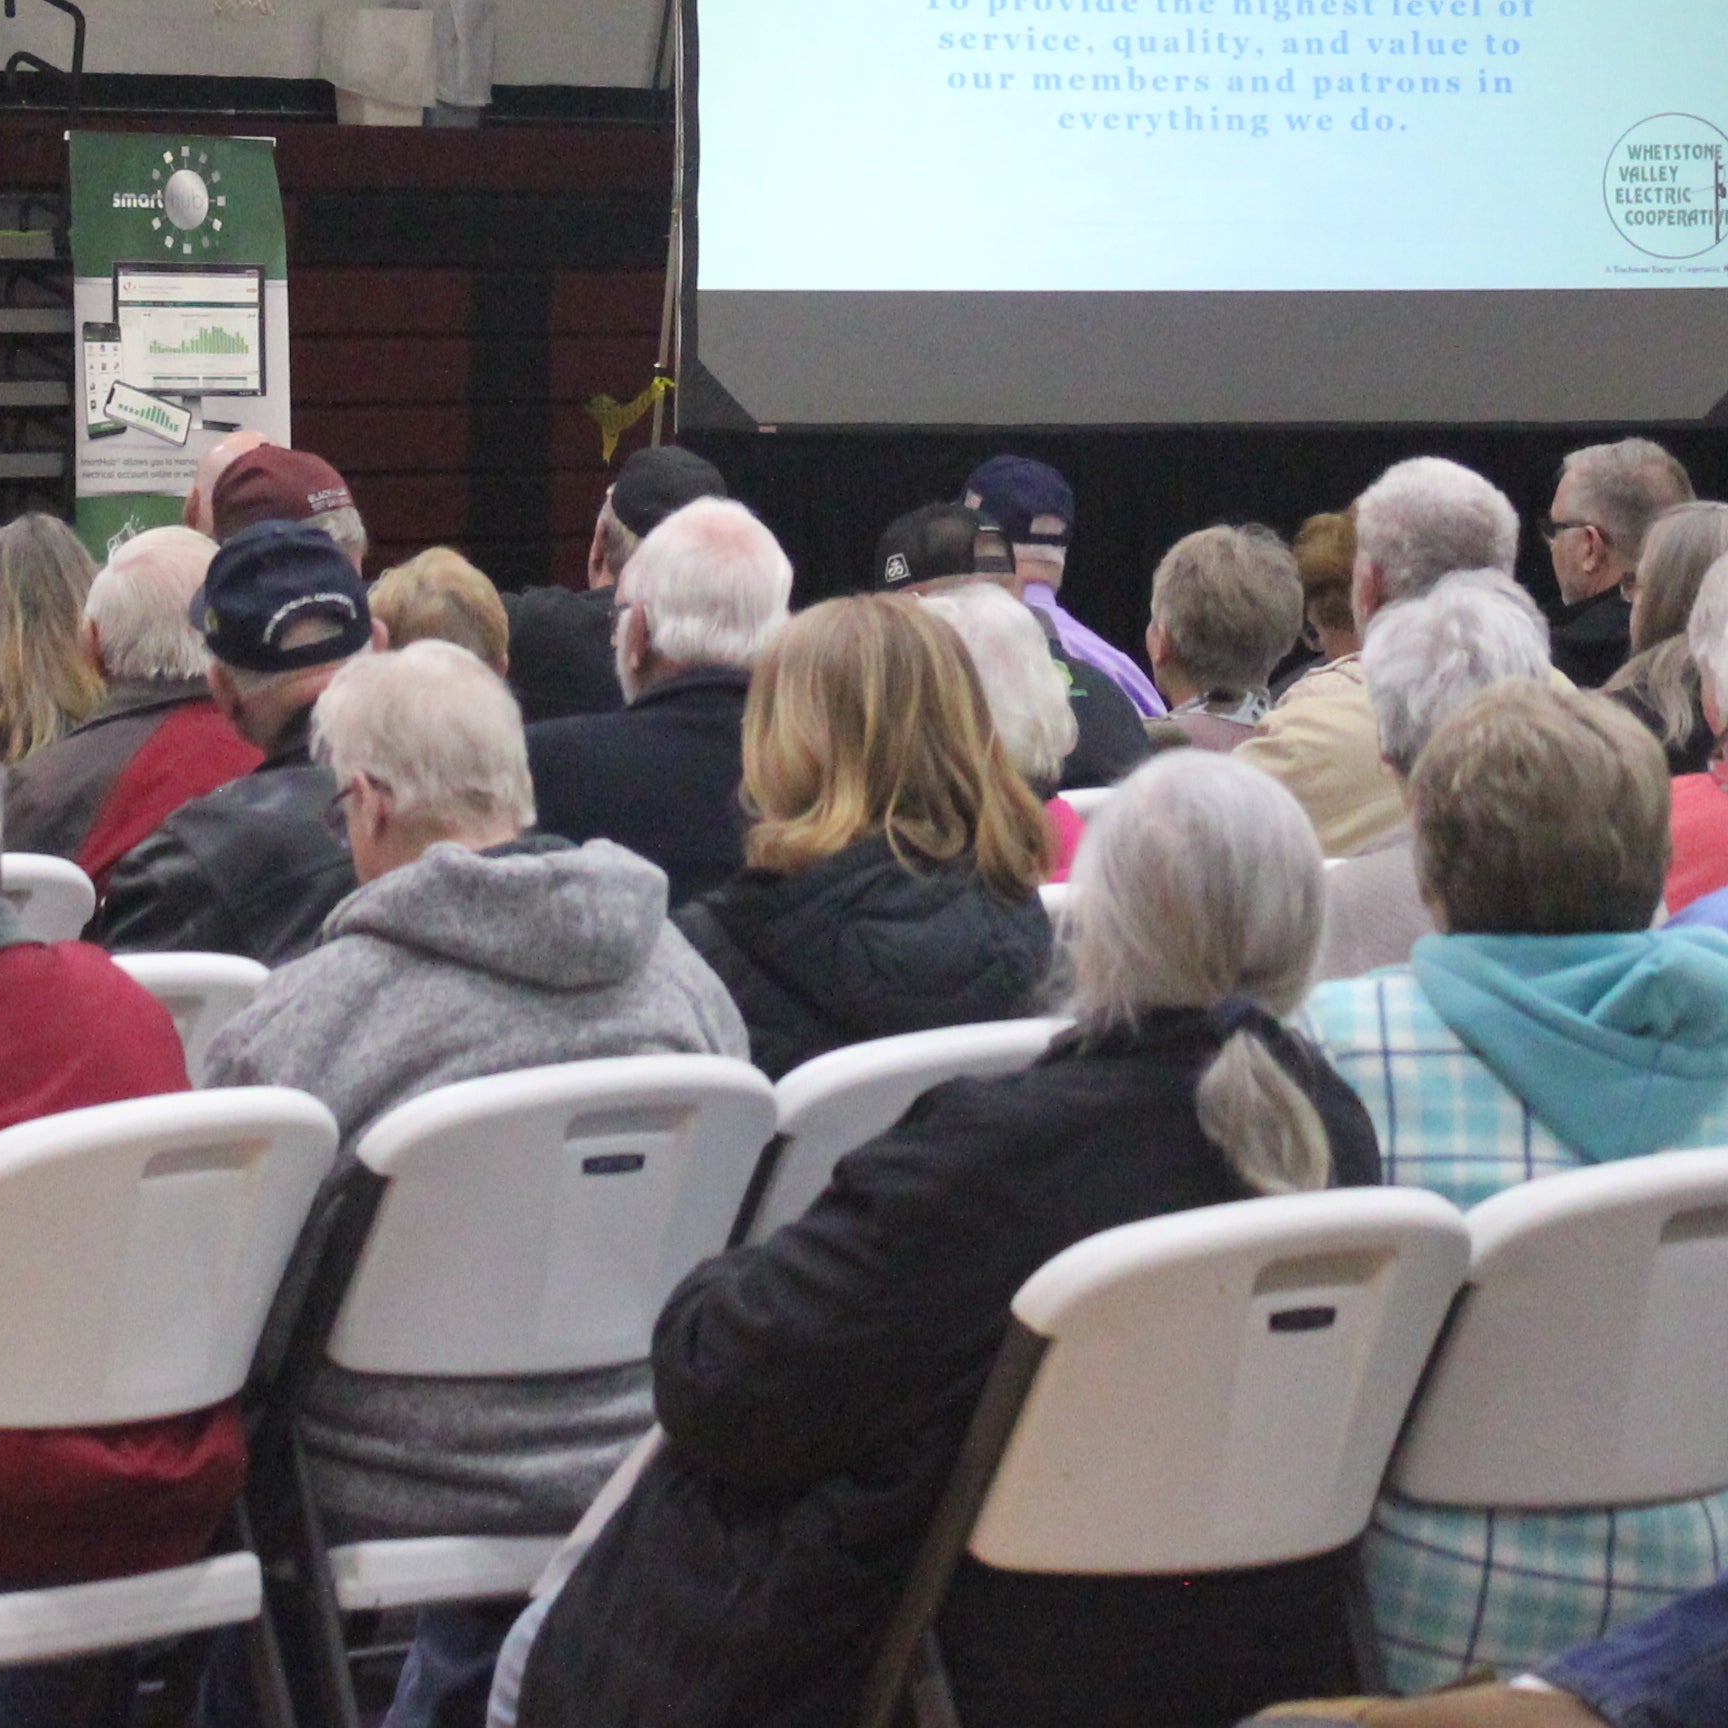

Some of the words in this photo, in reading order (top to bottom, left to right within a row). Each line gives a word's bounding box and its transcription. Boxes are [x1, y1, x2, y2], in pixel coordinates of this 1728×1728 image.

[939, 26, 1094, 54] service,
[1112, 27, 1264, 61] quality,
[1282, 29, 1350, 55] and
[1368, 30, 1469, 56] value
[1486, 34, 1520, 55] to
[947, 72, 1014, 90] our
[1033, 65, 1211, 93] members
[1228, 68, 1295, 93] and
[1314, 72, 1461, 99] patrons
[1479, 69, 1512, 94] in
[1057, 106, 1271, 140] everything
[1285, 114, 1333, 132] we
[1351, 106, 1407, 131] do.
[1627, 144, 1723, 161] WHETSTONE
[1618, 166, 1679, 183] VALLEY
[1615, 187, 1691, 204] ELECTRIC
